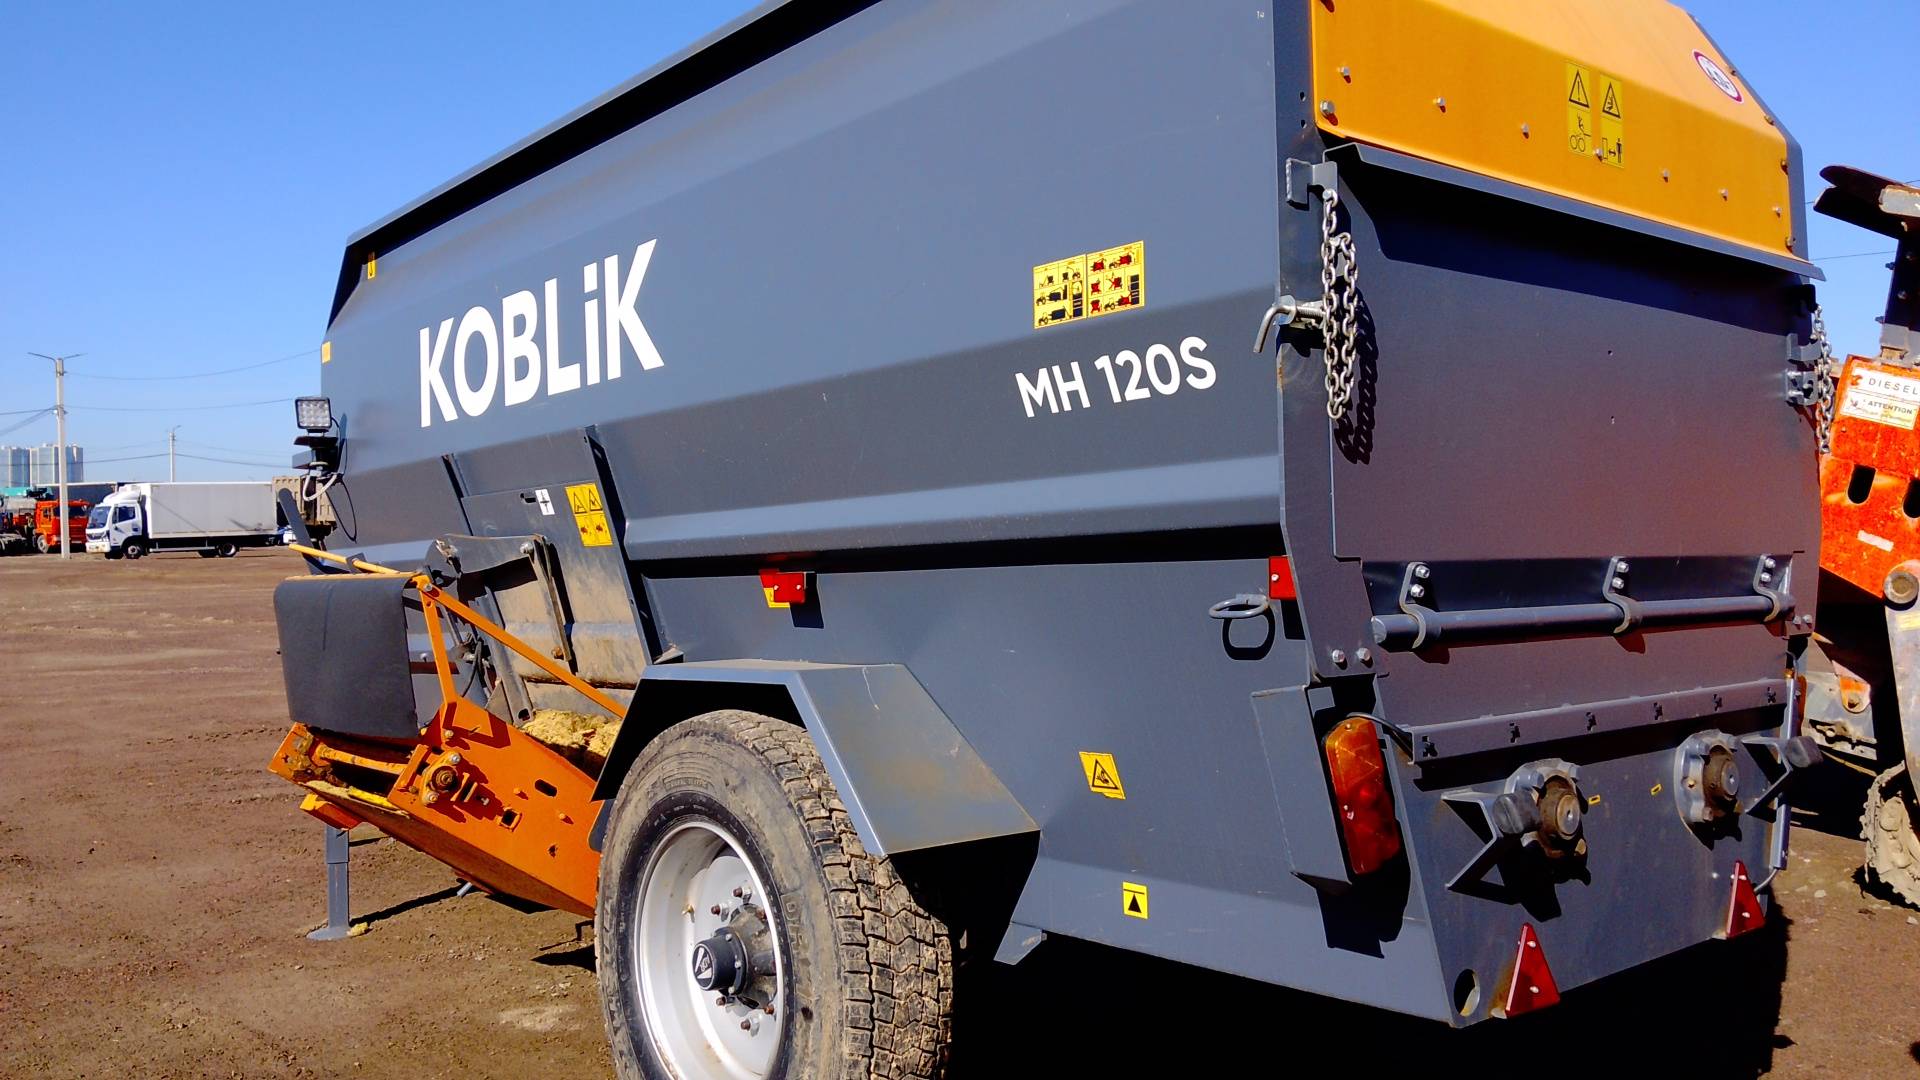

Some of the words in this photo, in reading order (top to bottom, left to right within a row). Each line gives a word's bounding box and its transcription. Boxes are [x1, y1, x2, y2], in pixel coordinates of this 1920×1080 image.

[419, 238, 664, 428] KOBLiK
[1015, 361, 1091, 418] MH
[1094, 336, 1217, 404] 120S
[1868, 377, 1918, 395] DIESEL
